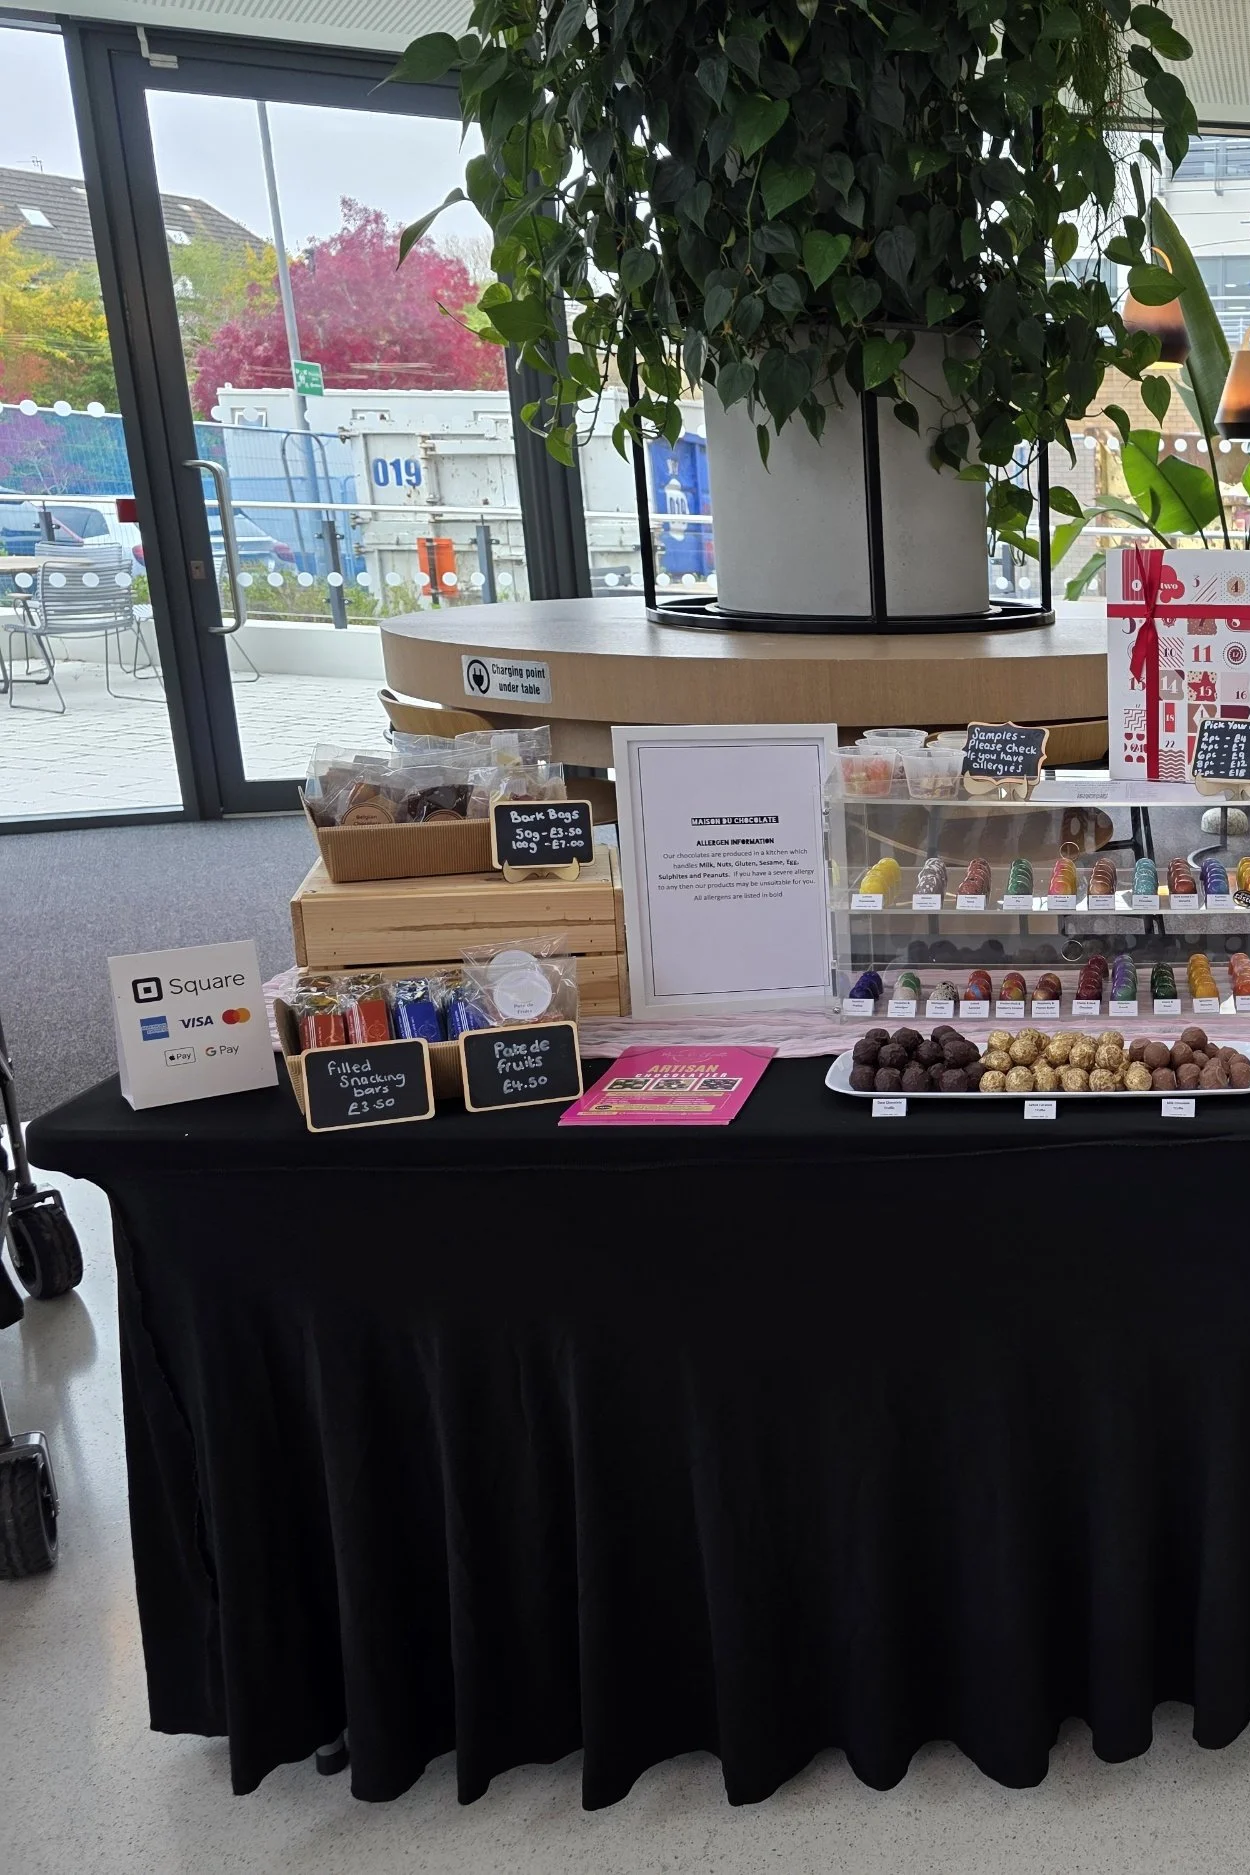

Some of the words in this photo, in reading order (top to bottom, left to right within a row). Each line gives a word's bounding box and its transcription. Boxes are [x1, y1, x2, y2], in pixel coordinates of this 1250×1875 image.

[372, 457, 422, 488] 019
[1191, 645, 1213, 663] 11
[491, 663, 524, 679] Charging
[525, 667, 546, 680] point
[498, 682, 519, 693] under
[520, 683, 541, 695] table
[1160, 676, 1178, 694] 14
[1200, 685, 1212, 697] 15
[1235, 690, 1248, 700] 16
[1204, 720, 1225, 730] Pick
[1227, 721, 1247, 731] Your
[972, 727, 1018, 743] Samples
[1201, 732, 1220, 743] 2pc
[1233, 733, 1247, 743] £4
[968, 739, 1003, 751] Please
[1200, 742, 1219, 752] 4pc
[1231, 743, 1245, 752] £7
[977, 752, 997, 763] you
[1000, 751, 1024, 763] have
[1197, 750, 1217, 761] 6pc
[1231, 752, 1245, 760] £9
[972, 760, 1023, 776] allergies
[510, 810, 545, 823] Bark
[547, 808, 580, 823] Bags
[691, 816, 721, 826] MAISON
[722, 816, 733, 825] DU
[733, 815, 777, 825] CHOCOLATE
[696, 838, 730, 847] ALLERGEN
[731, 837, 775, 846] INFORMATION
[168, 972, 246, 996] Square
[178, 1015, 214, 1029] VISA
[219, 1045, 240, 1056] Pay
[530, 1039, 550, 1052] de
[176, 1051, 192, 1061] Pay
[647, 1064, 720, 1073] ARTISAN
[339, 1073, 406, 1088] Snacking
[502, 1075, 548, 1095] £4.50
[353, 1085, 390, 1098] bars
[348, 1098, 395, 1116] £3.50
